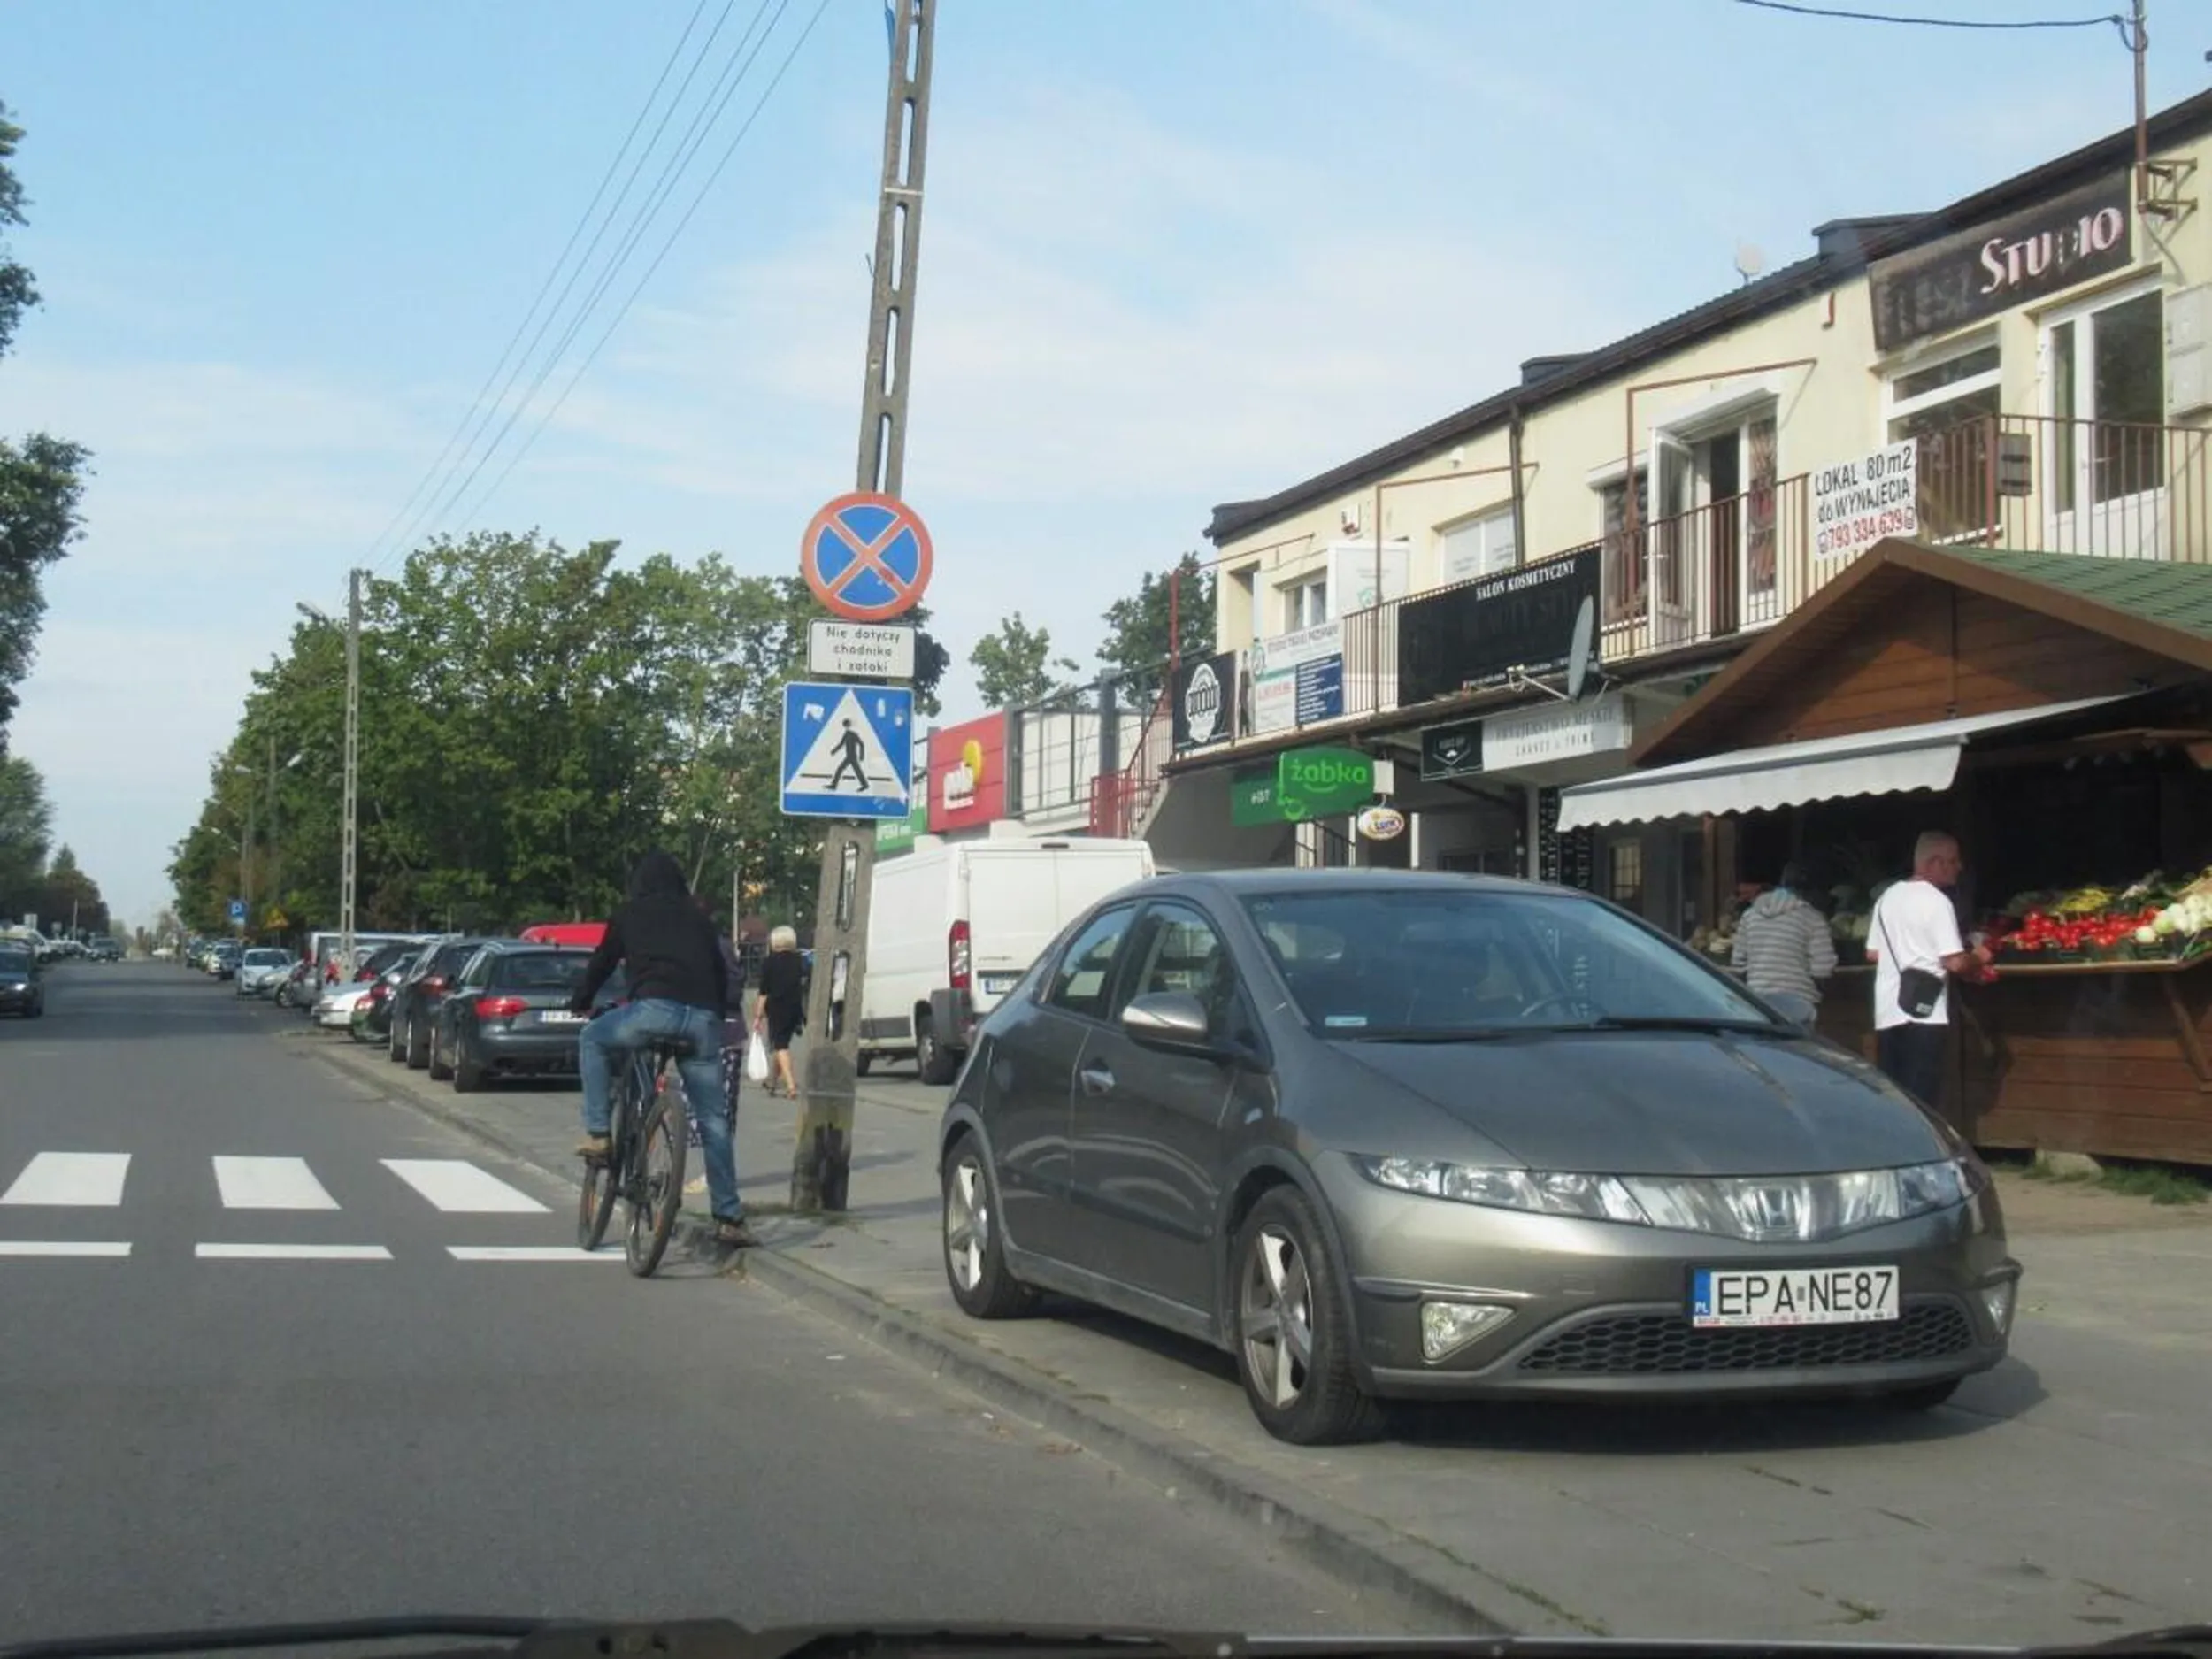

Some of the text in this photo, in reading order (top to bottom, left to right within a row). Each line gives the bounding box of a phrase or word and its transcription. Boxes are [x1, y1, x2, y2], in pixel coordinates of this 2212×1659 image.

[1815, 445, 1911, 496] LOKAL 80 m2
[1818, 501, 1833, 524] do
[1828, 508, 1903, 549] 793 334 639
[1476, 559, 1576, 601] SALON KOSMETYCZNY
[826, 626, 901, 644] Nie dotyczy
[833, 644, 892, 657] chodnika
[849, 661, 888, 672] zatoki
[1290, 758, 1368, 784] żabka
[1717, 1271, 1893, 1316] EPA NE87
[1695, 1302, 1709, 1313] PL
